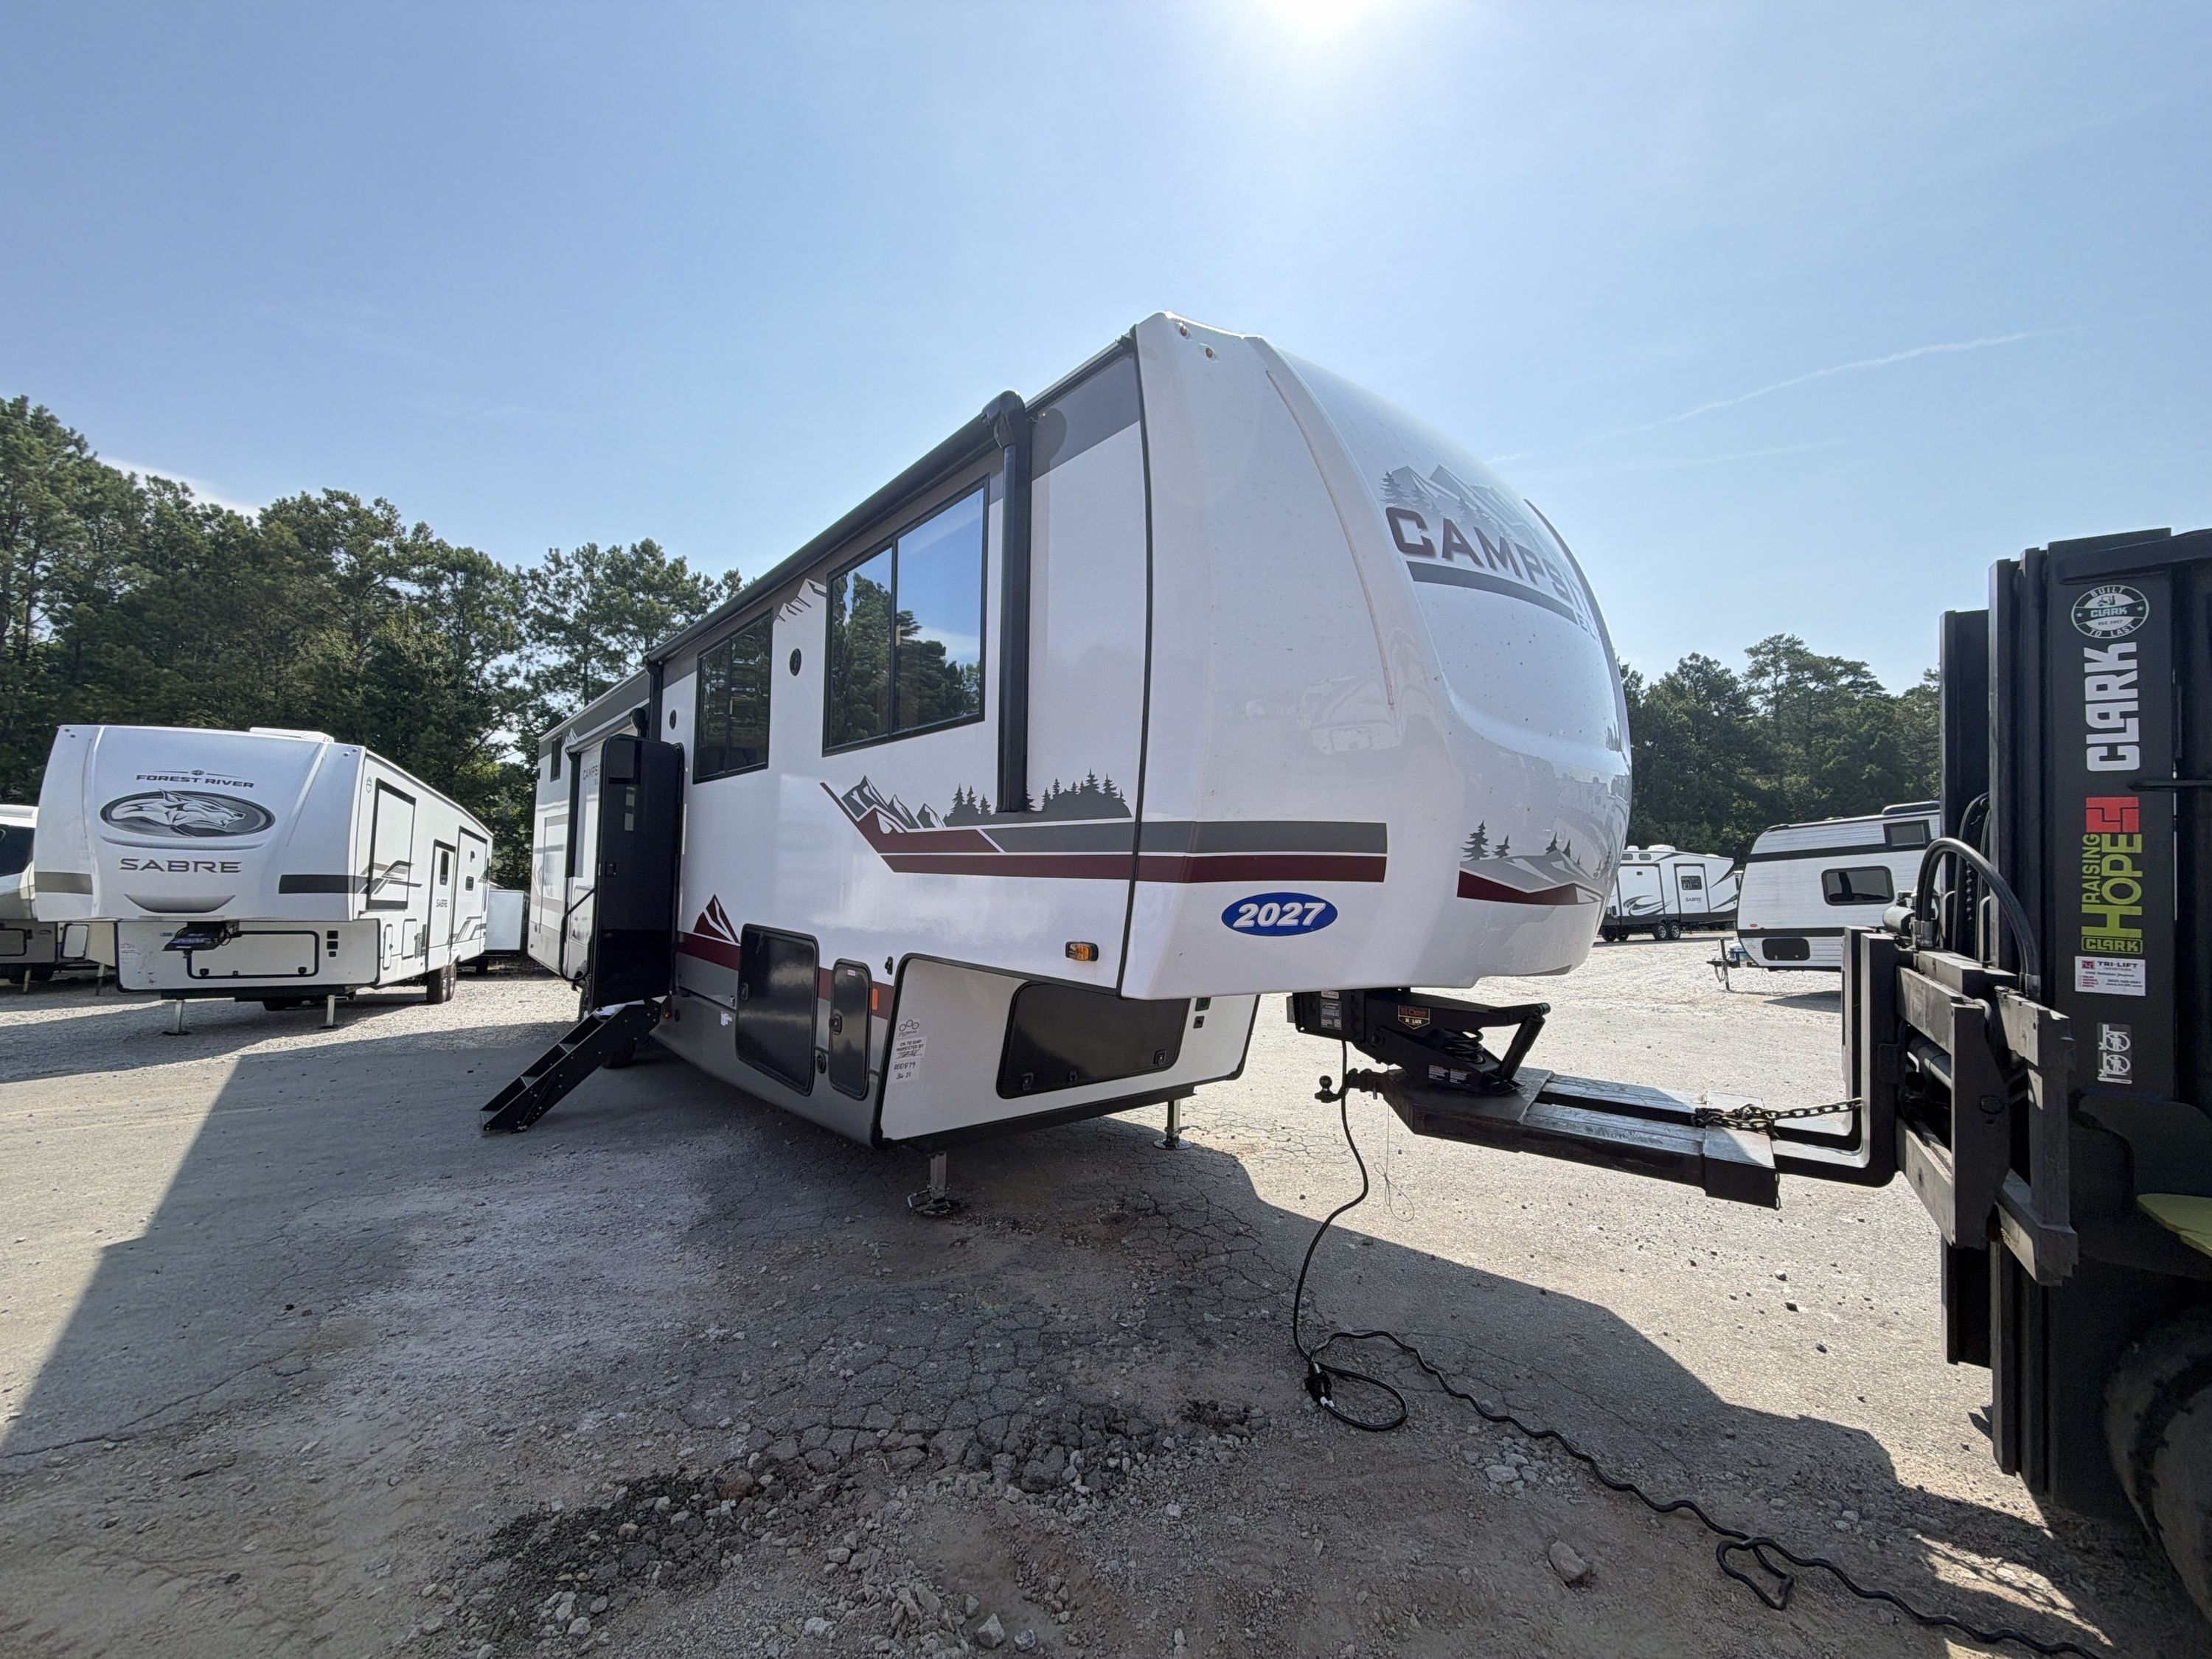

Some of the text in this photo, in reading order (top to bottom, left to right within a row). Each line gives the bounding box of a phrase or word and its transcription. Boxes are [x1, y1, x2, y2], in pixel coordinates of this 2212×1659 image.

[2090, 587, 2125, 597] BUILT
[2090, 607, 2127, 618] CLARK
[2090, 623, 2135, 638] TO LAST
[2084, 641, 2140, 772] CLARK
[136, 774, 254, 788] FOREST RIVER
[119, 858, 242, 873] SABRE
[2081, 834, 2101, 904] RAISING
[2081, 833, 2143, 939] HOPE
[1233, 901, 1326, 928] 2027
[2086, 939, 2138, 951] CLARK
